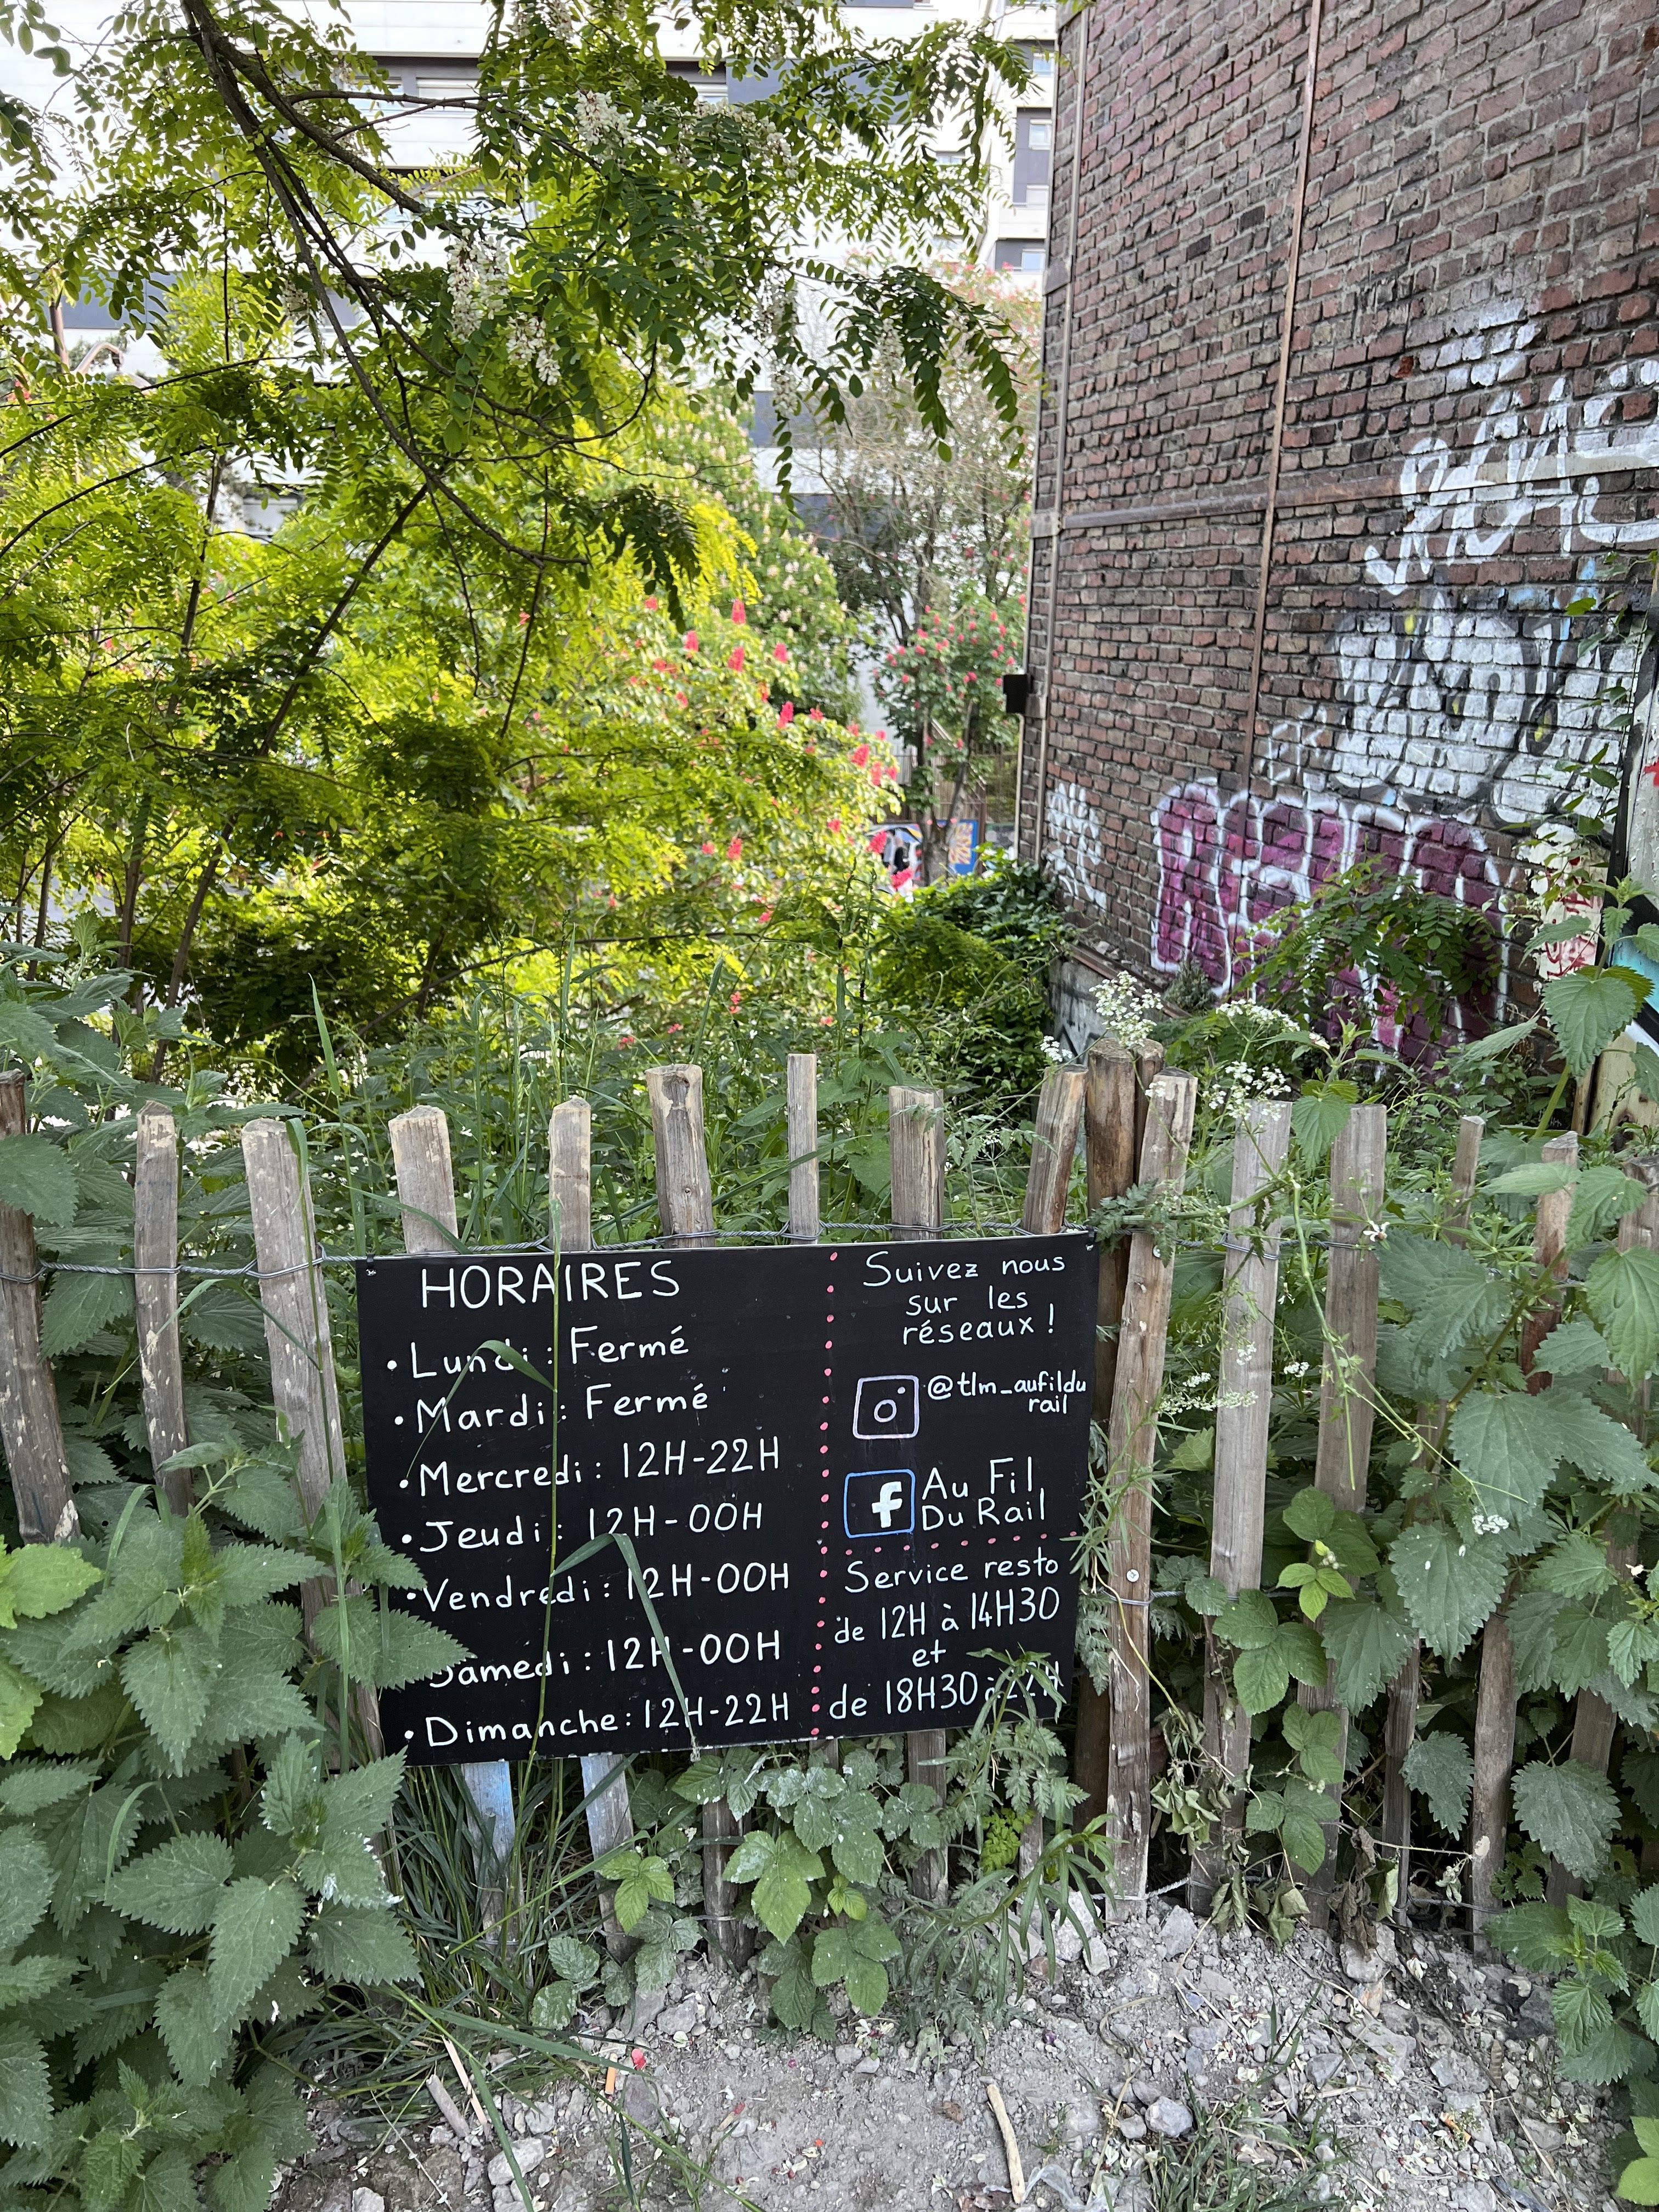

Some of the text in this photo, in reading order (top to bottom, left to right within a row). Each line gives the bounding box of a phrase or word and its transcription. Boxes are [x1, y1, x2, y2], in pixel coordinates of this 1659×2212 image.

[421, 1260, 680, 1310] HORAIRES
[862, 1250, 1065, 1287] Suivez nous
[905, 1284, 1029, 1317] sur les
[570, 1324, 690, 1365] Fermé
[586, 1382, 708, 1420] Fermé
[1028, 1393, 1068, 1415] rail
[921, 1455, 1032, 1500] Au Fil
[921, 1487, 1045, 1531] Du Rail
[844, 1545, 1059, 1593] Service resto
[834, 1585, 1060, 1644] de 12H à 14H30
[912, 1638, 947, 1668] et
[828, 1683, 868, 1720] de
[885, 1671, 978, 1715] 18H30
